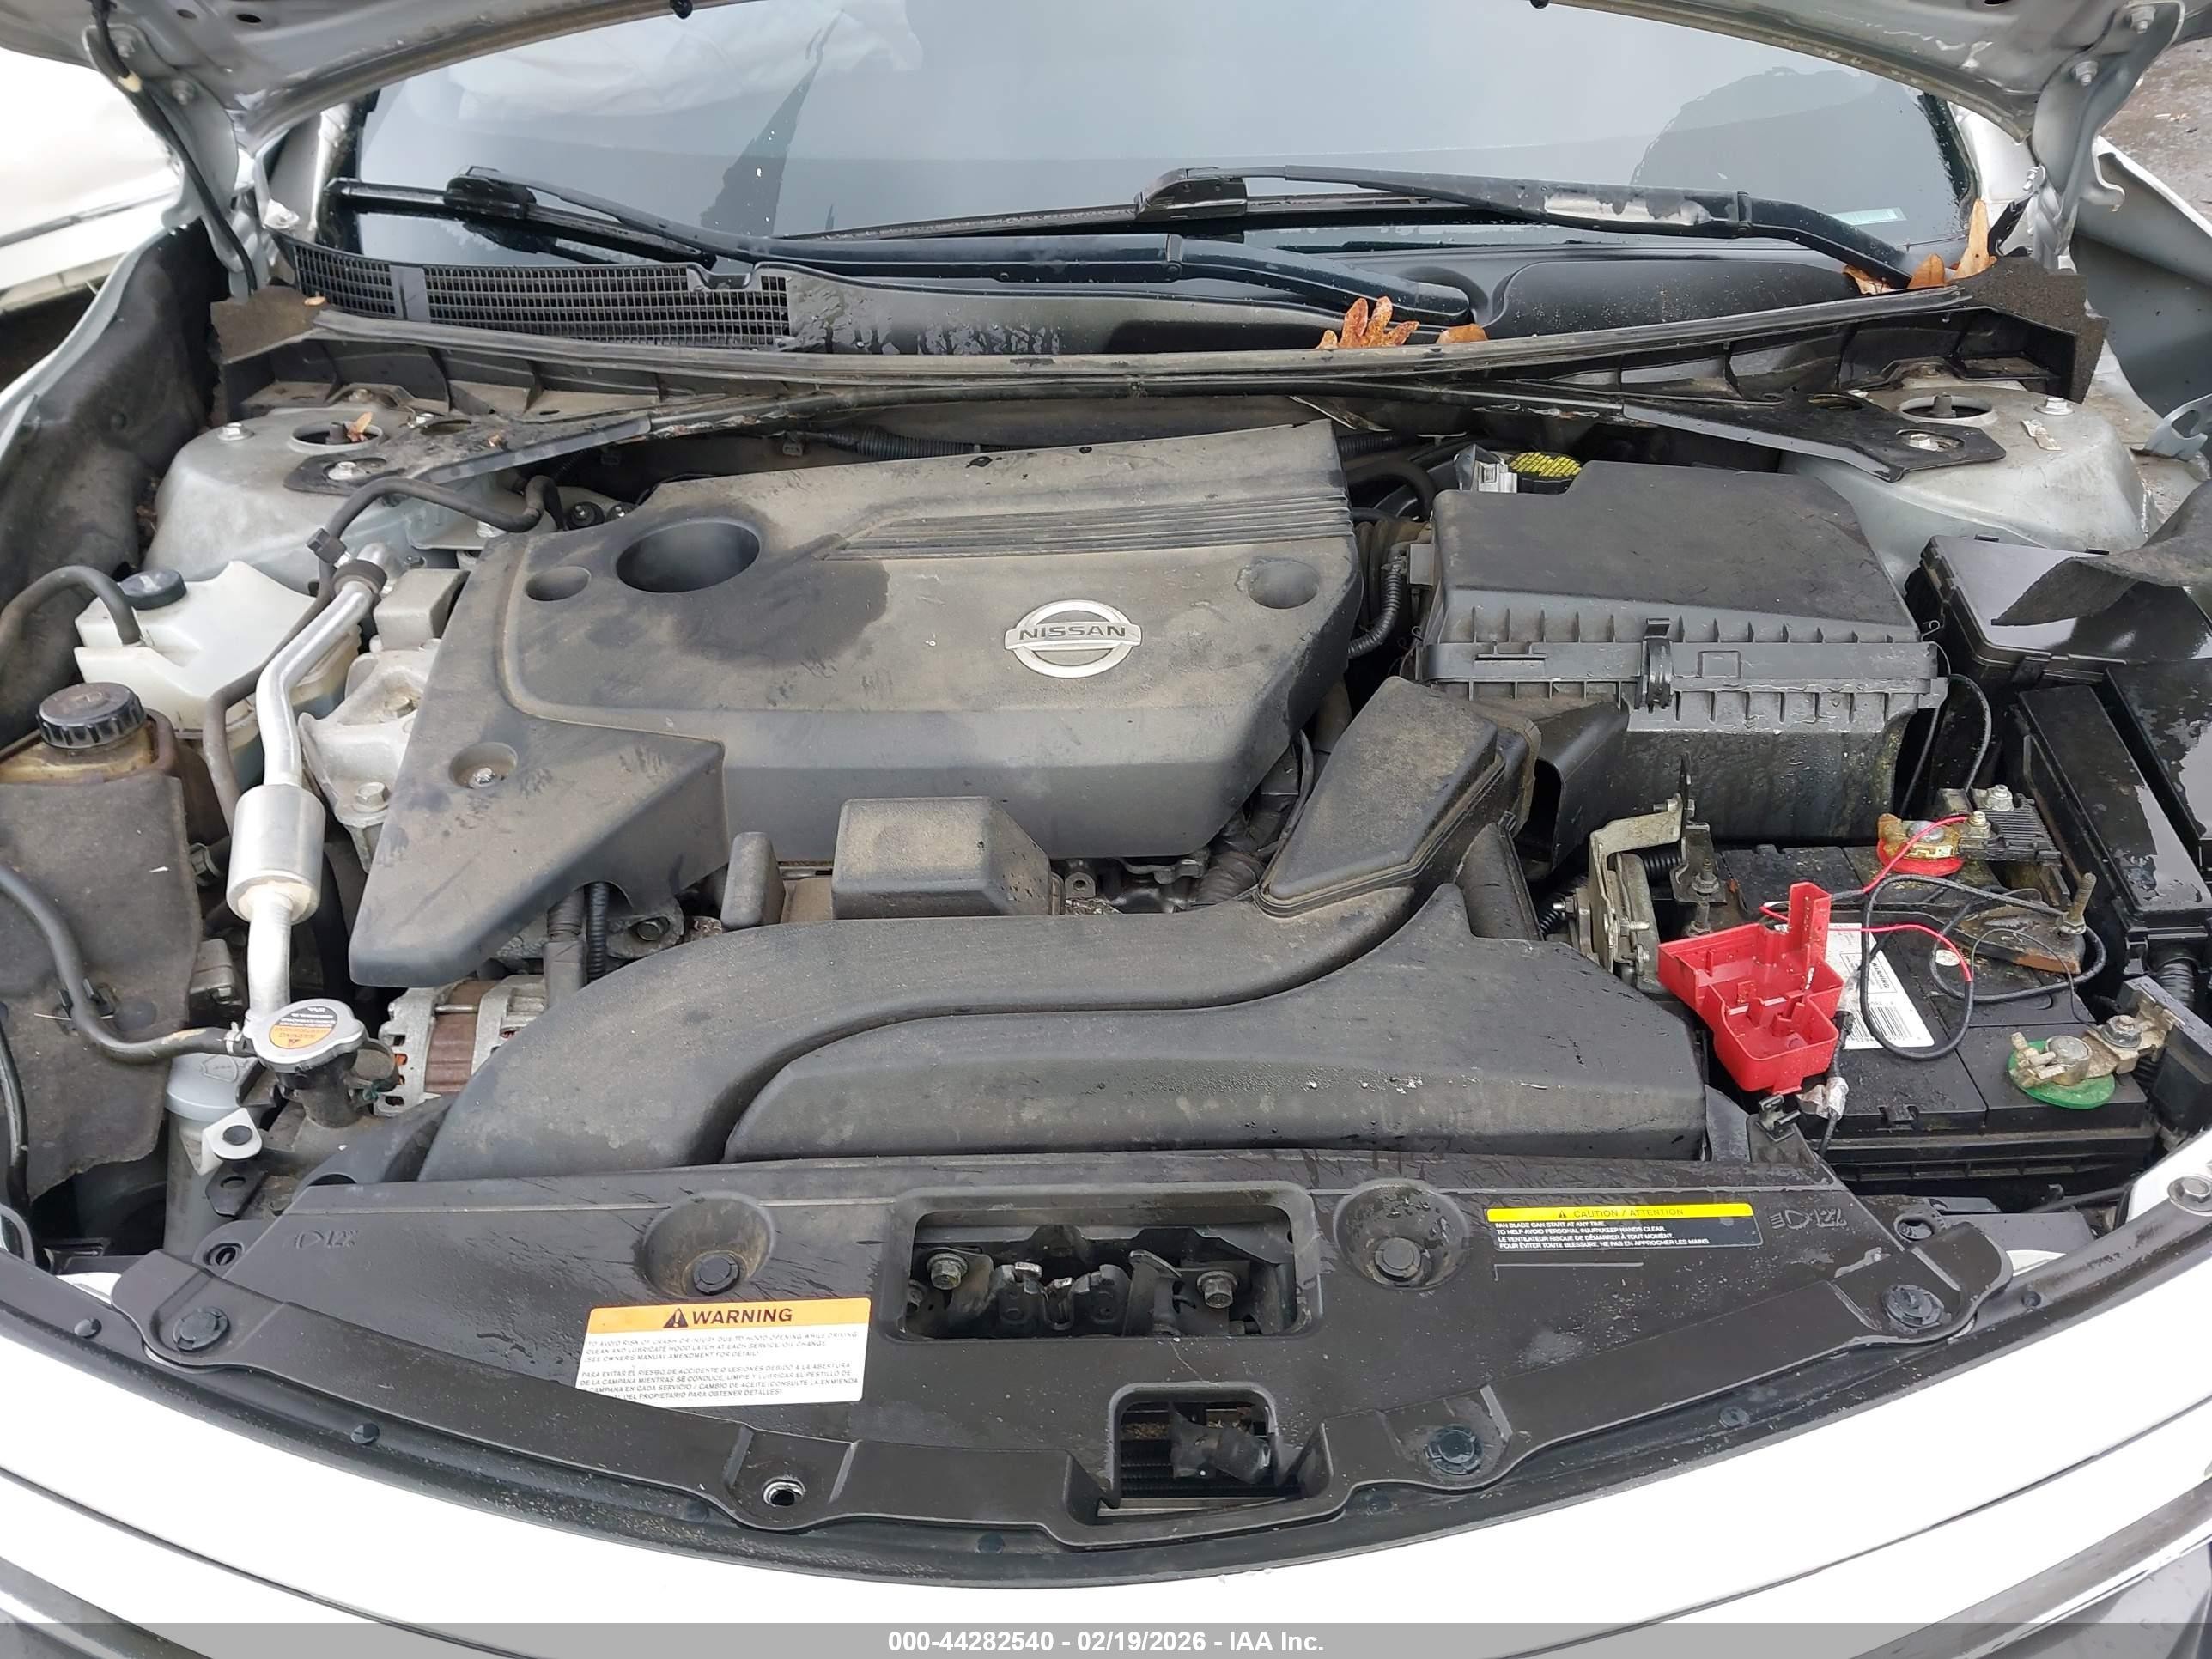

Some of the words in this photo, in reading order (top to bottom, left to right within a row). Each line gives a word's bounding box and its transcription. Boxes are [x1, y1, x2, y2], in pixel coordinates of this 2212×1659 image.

[1019, 625, 1126, 641] NISSAN
[1630, 1208, 1684, 1217] ATTENTION
[692, 1308, 793, 1325] WARNING
